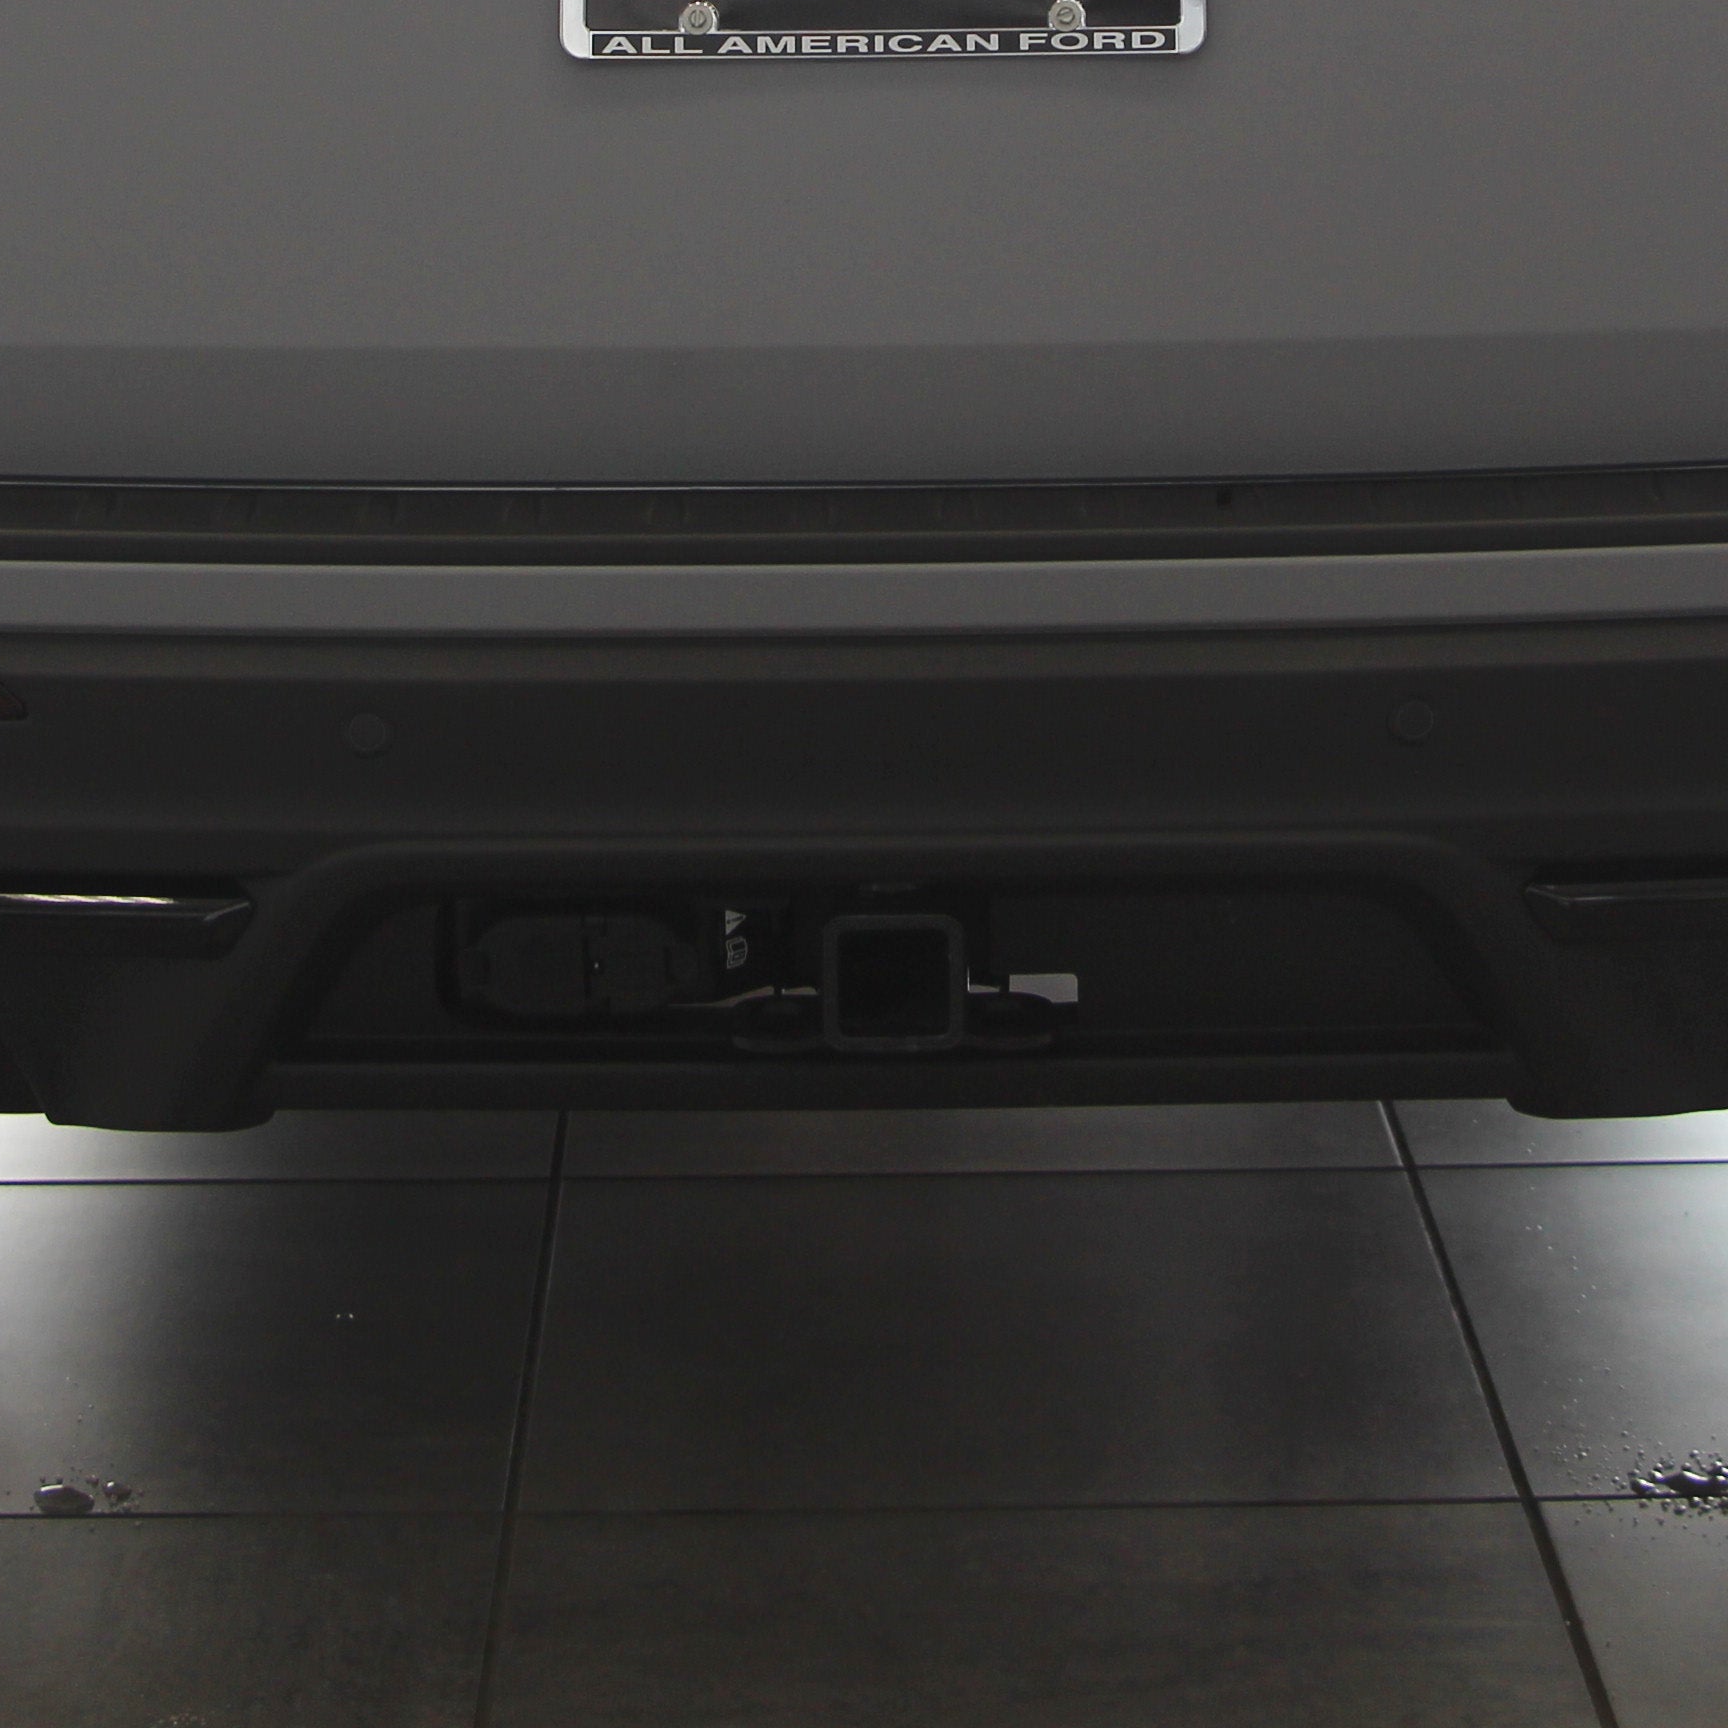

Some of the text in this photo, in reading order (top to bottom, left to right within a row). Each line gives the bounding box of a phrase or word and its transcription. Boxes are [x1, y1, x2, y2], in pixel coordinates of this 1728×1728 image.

[601, 30, 1167, 55] ALL AMERICAN FORD
